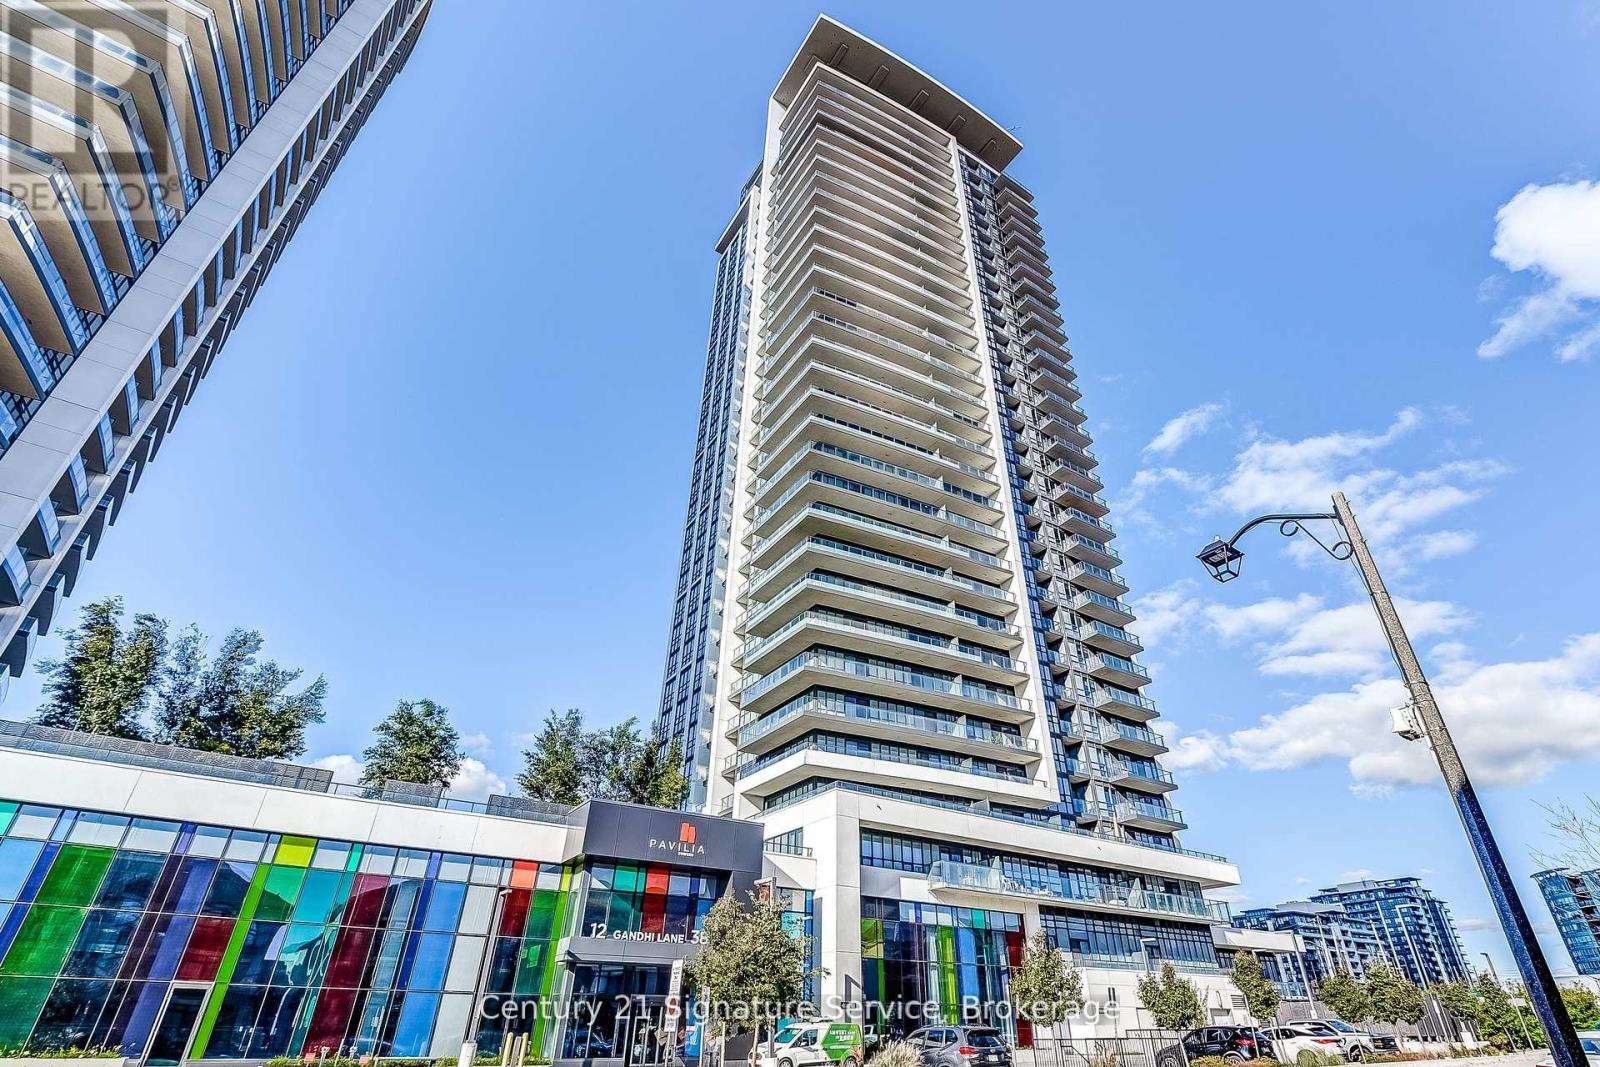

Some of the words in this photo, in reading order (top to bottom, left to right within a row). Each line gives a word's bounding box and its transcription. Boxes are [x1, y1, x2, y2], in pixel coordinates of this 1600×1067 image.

[649, 838, 705, 855] PAVILIA
[590, 922, 607, 939] 12
[613, 930, 655, 942] GANDHI
[657, 933, 685, 944] LANE
